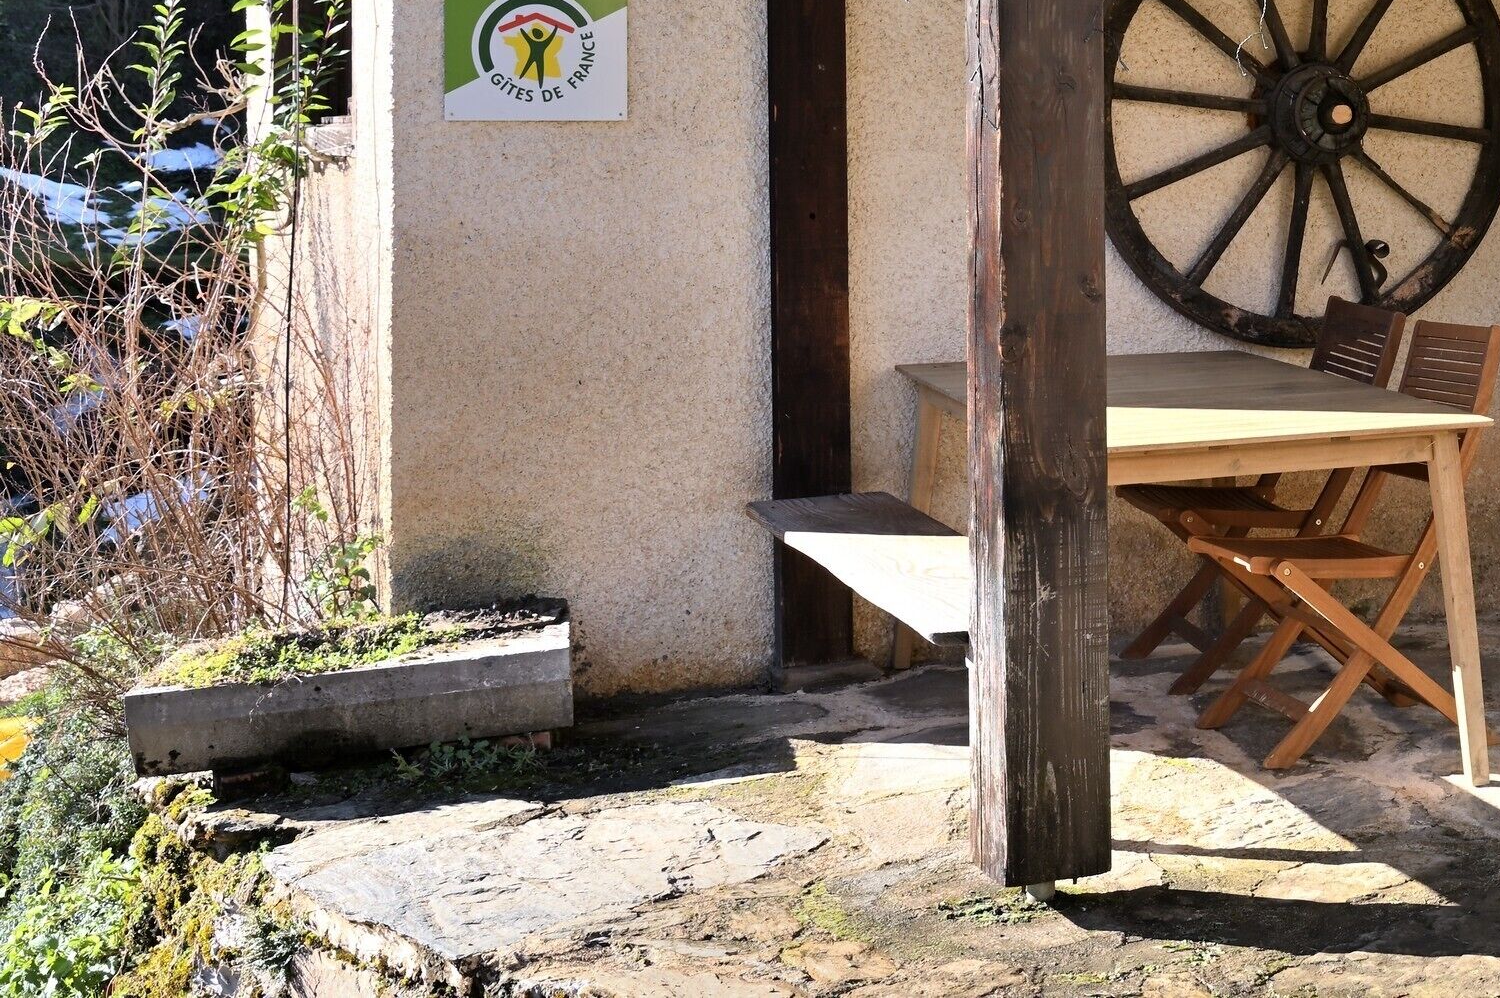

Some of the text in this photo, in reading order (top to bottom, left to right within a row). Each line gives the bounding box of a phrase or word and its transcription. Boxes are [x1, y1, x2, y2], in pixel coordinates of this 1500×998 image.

[490, 31, 595, 103] GÎTES DE FRANCE
